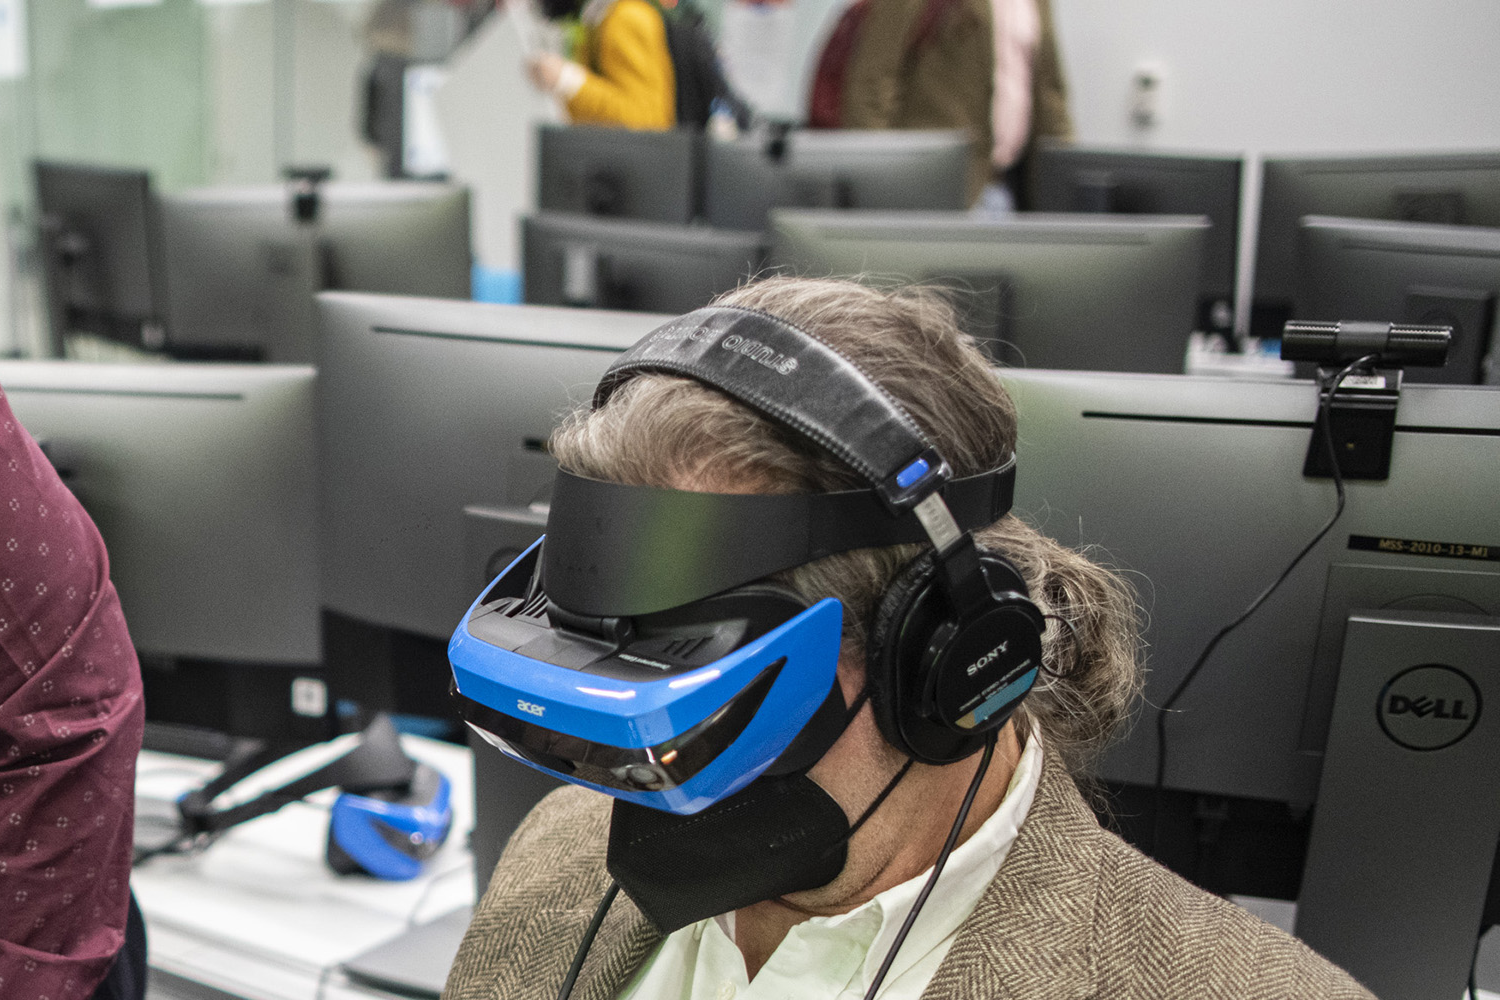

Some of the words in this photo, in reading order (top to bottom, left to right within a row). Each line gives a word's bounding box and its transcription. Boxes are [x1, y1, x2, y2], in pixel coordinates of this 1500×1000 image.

[721, 334, 799, 376] STUDIO
[966, 640, 1008, 677] SONY
[517, 699, 546, 717] acer
[1388, 694, 1469, 720] DELL
